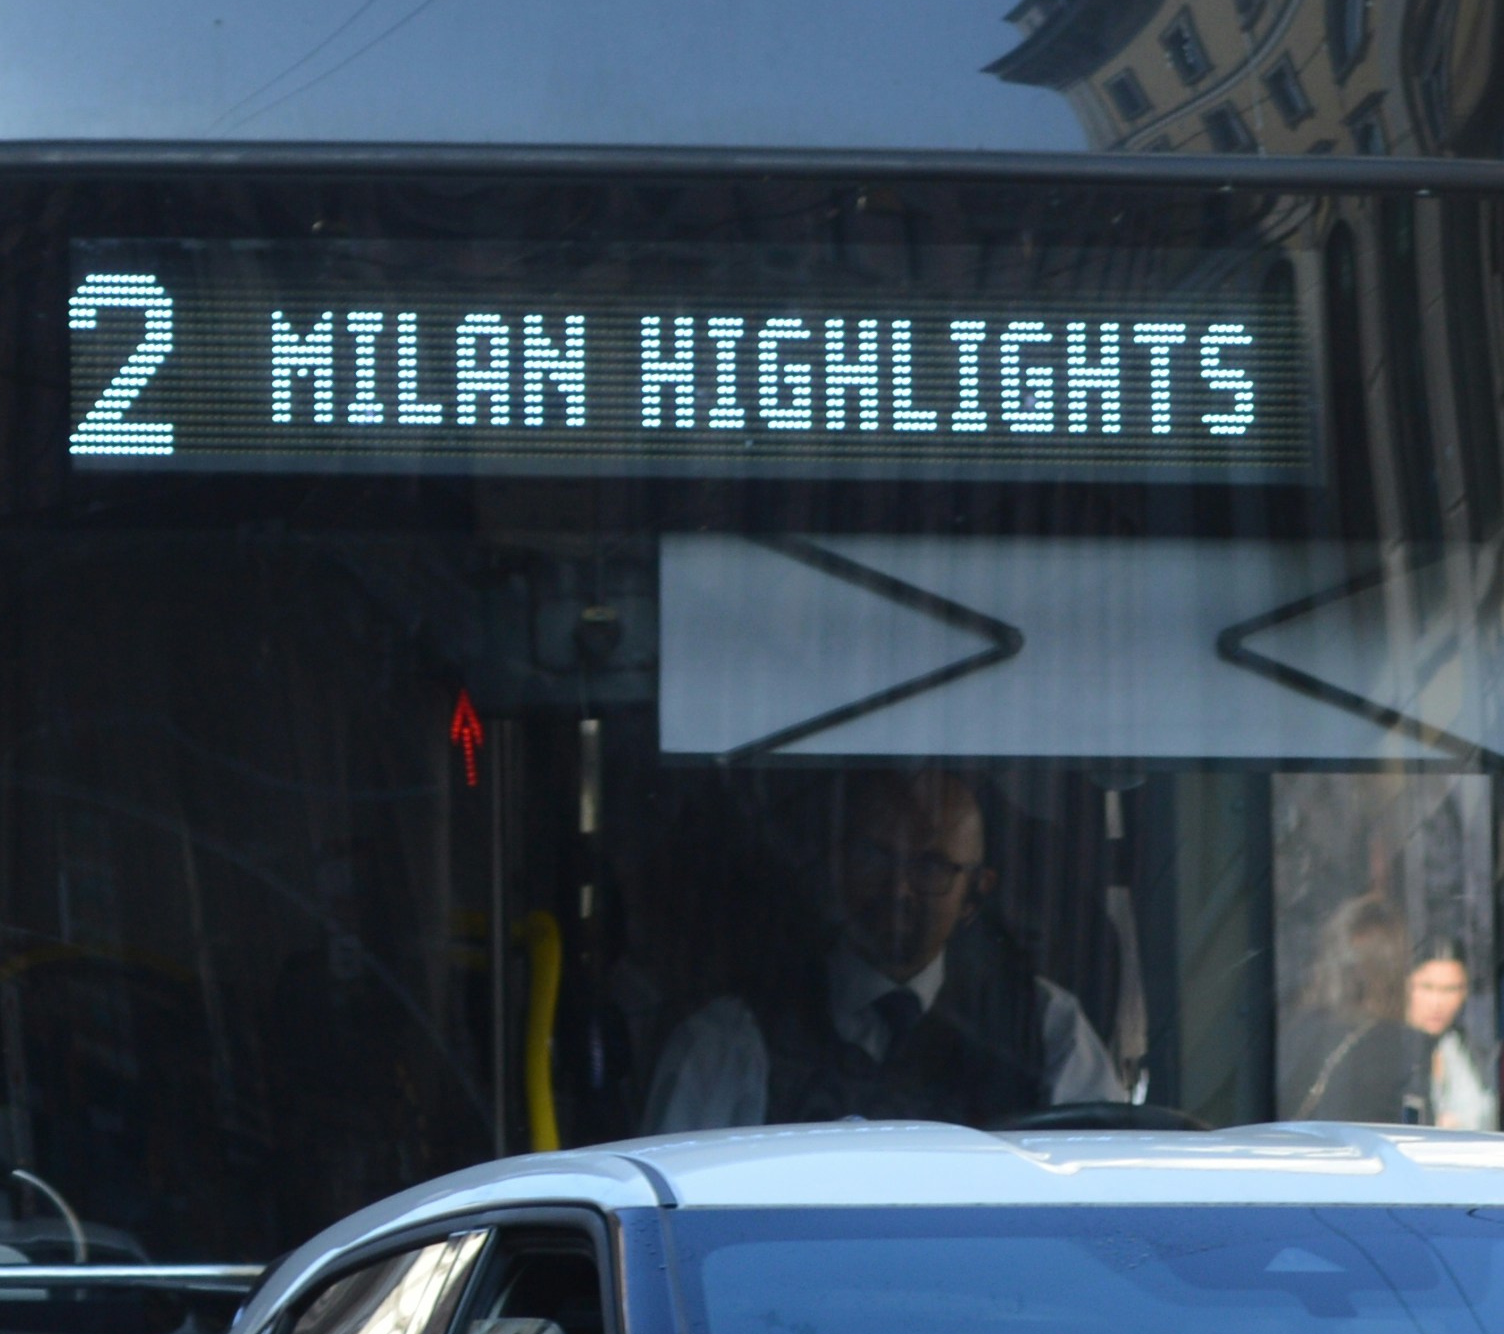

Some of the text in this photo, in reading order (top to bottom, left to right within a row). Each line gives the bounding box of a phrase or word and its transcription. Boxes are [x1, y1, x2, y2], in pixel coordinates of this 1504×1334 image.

[67, 273, 1255, 455] 2 MILAN HIGHLIGHTS
